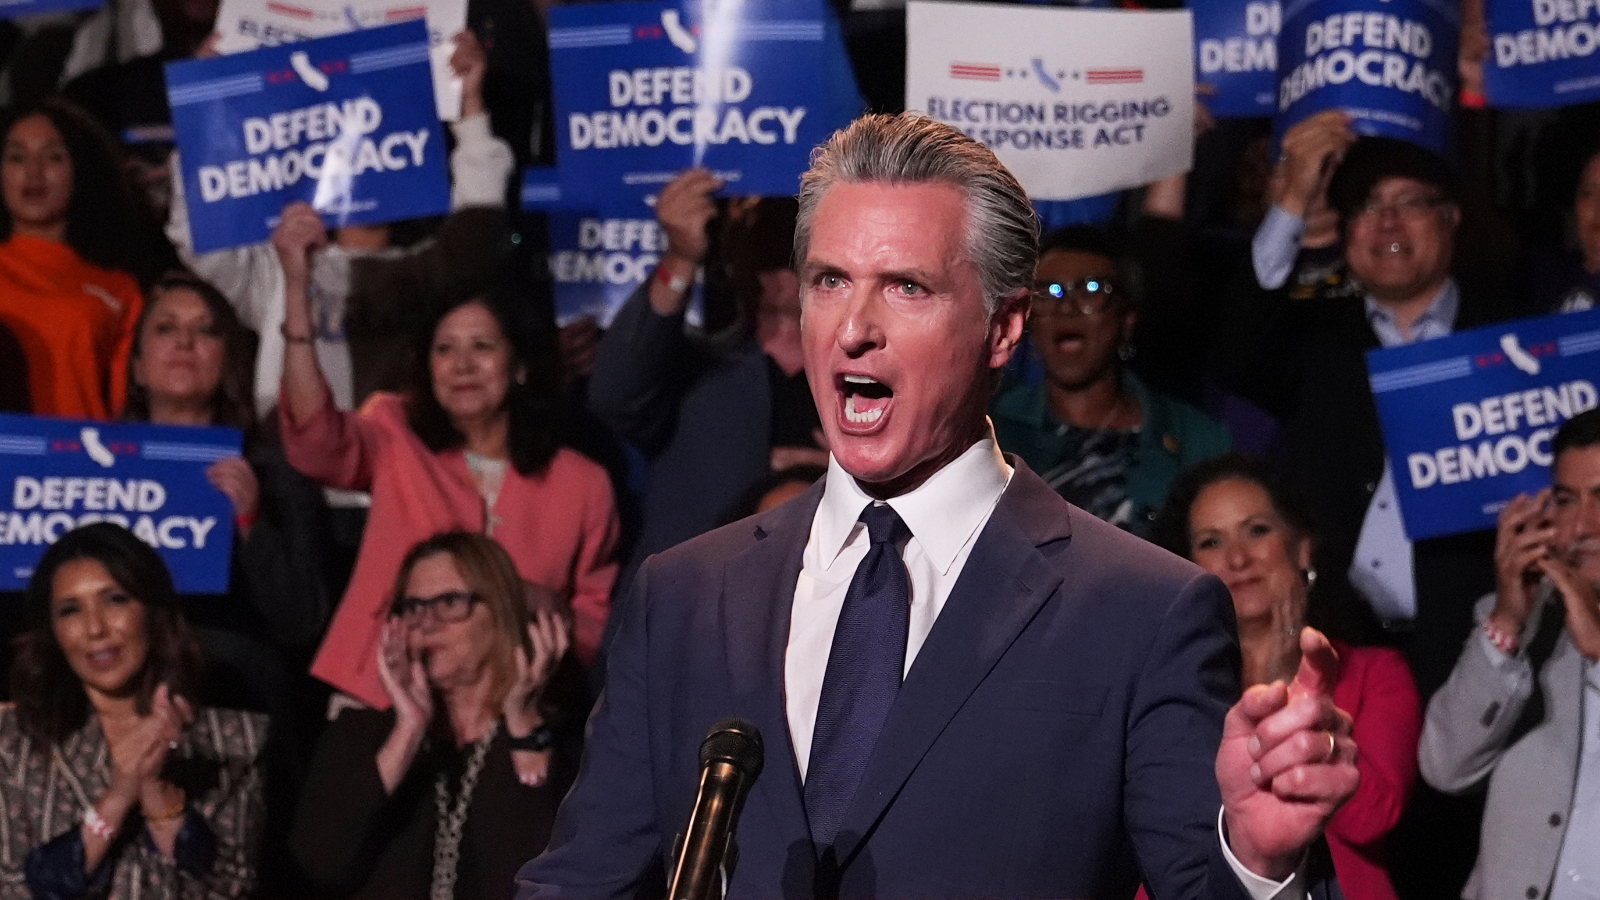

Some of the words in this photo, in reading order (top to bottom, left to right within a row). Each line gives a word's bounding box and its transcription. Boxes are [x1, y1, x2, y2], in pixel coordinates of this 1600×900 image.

[1532, 0, 1600, 26] DEF
[1305, 11, 1432, 58] DEFEND
[243, 96, 382, 155] DEFEND
[927, 97, 1045, 124] ELECTION
[1053, 95, 1171, 125] RIGGING
[964, 126, 1085, 150] SPONSE
[1093, 123, 1147, 147] ACT
[1452, 380, 1599, 441] DEFEND
[1406, 428, 1557, 490] DEMOC
[13, 476, 167, 513] DEFEND
